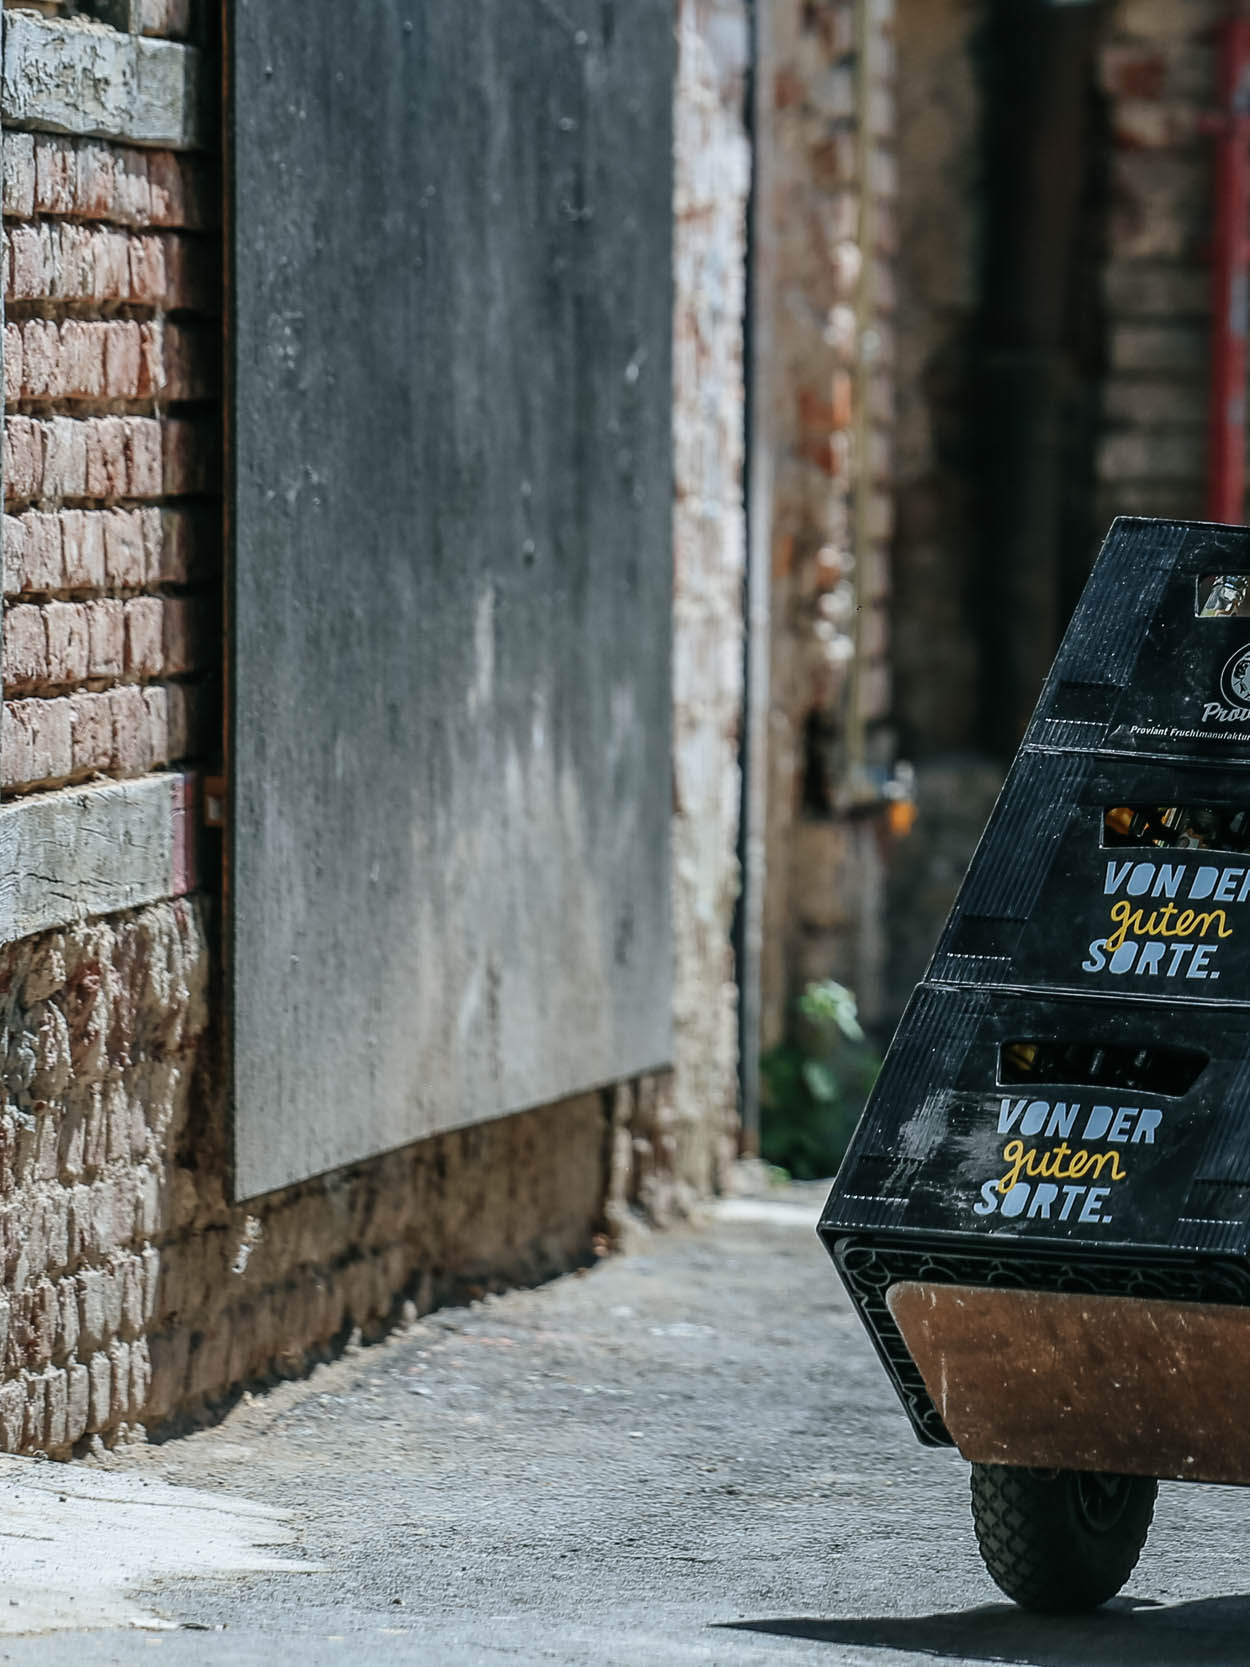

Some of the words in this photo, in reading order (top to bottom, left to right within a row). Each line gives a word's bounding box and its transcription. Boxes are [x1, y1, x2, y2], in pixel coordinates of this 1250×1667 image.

[1130, 725, 1168, 737] Proviant
[1103, 860, 1187, 898] VON
[1105, 900, 1233, 952] guten
[1081, 938, 1221, 979] SORTE.
[997, 1098, 1081, 1139] VON
[1081, 1105, 1164, 1144] DER
[997, 1139, 1127, 1194] guten
[973, 1179, 1113, 1224] SORTE.
